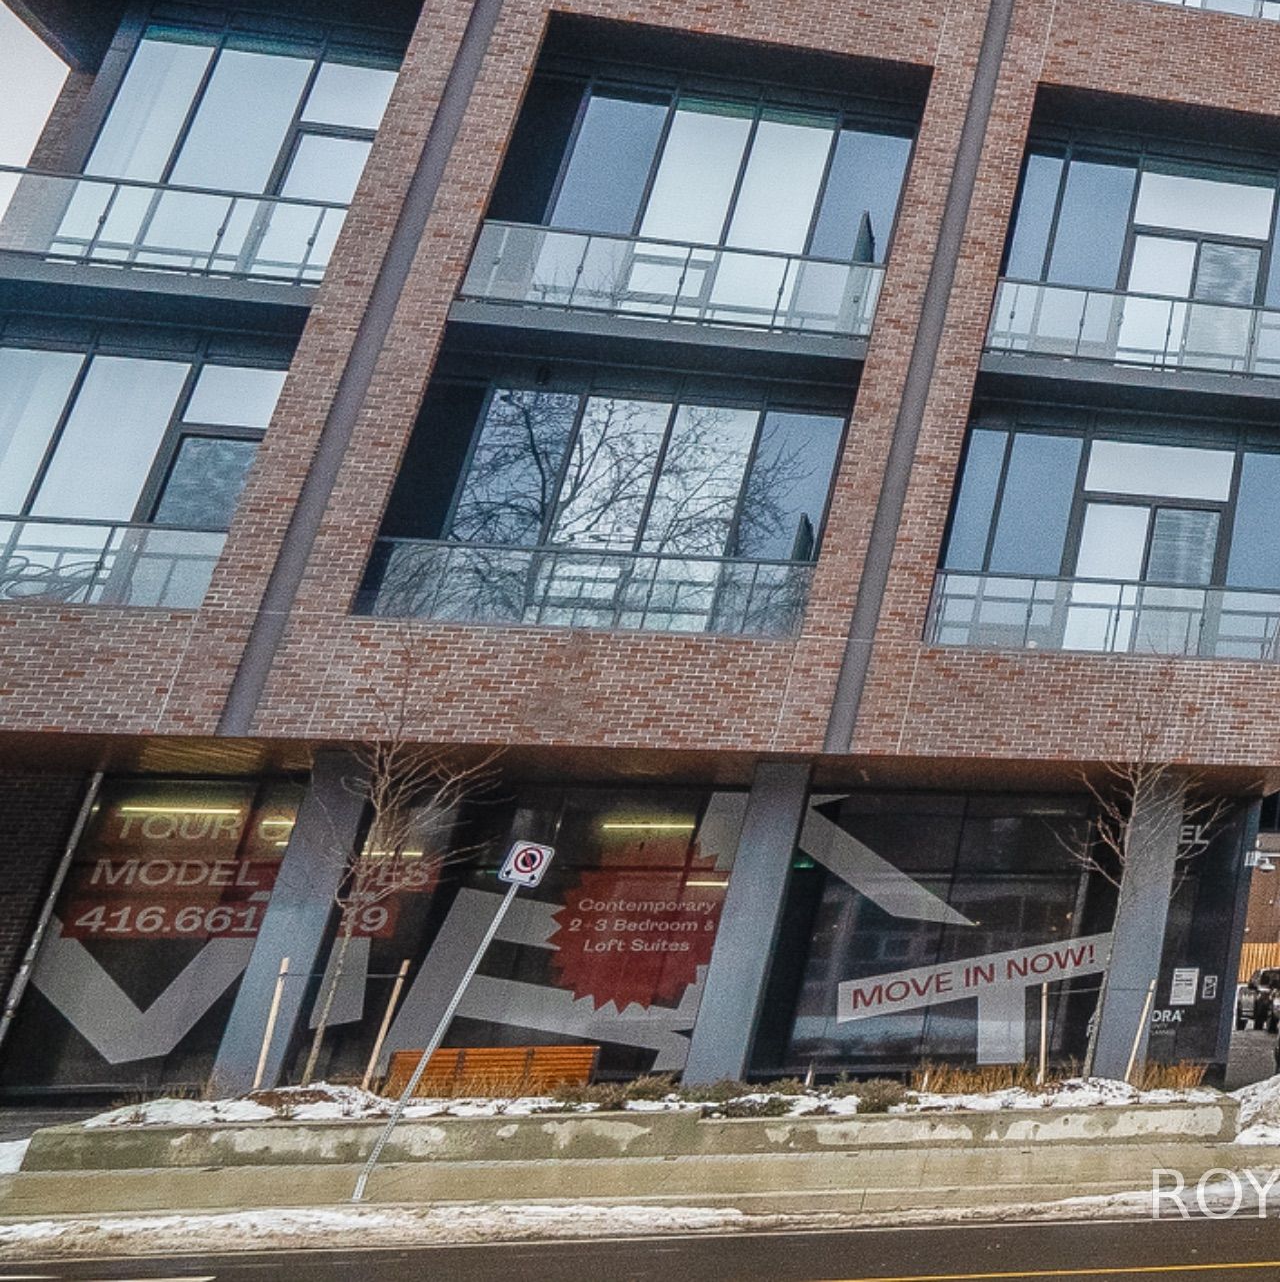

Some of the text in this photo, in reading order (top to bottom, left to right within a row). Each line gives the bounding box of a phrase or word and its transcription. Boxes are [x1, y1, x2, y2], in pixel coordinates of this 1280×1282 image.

[118, 815, 242, 840] TOUR
[90, 859, 260, 887] MODEL
[578, 898, 717, 915] Contemporary
[613, 918, 698, 932] Bedroom
[704, 920, 714, 932] &
[583, 938, 690, 953] Loft Suites
[852, 944, 1096, 1010] MOVE IN NOW!
